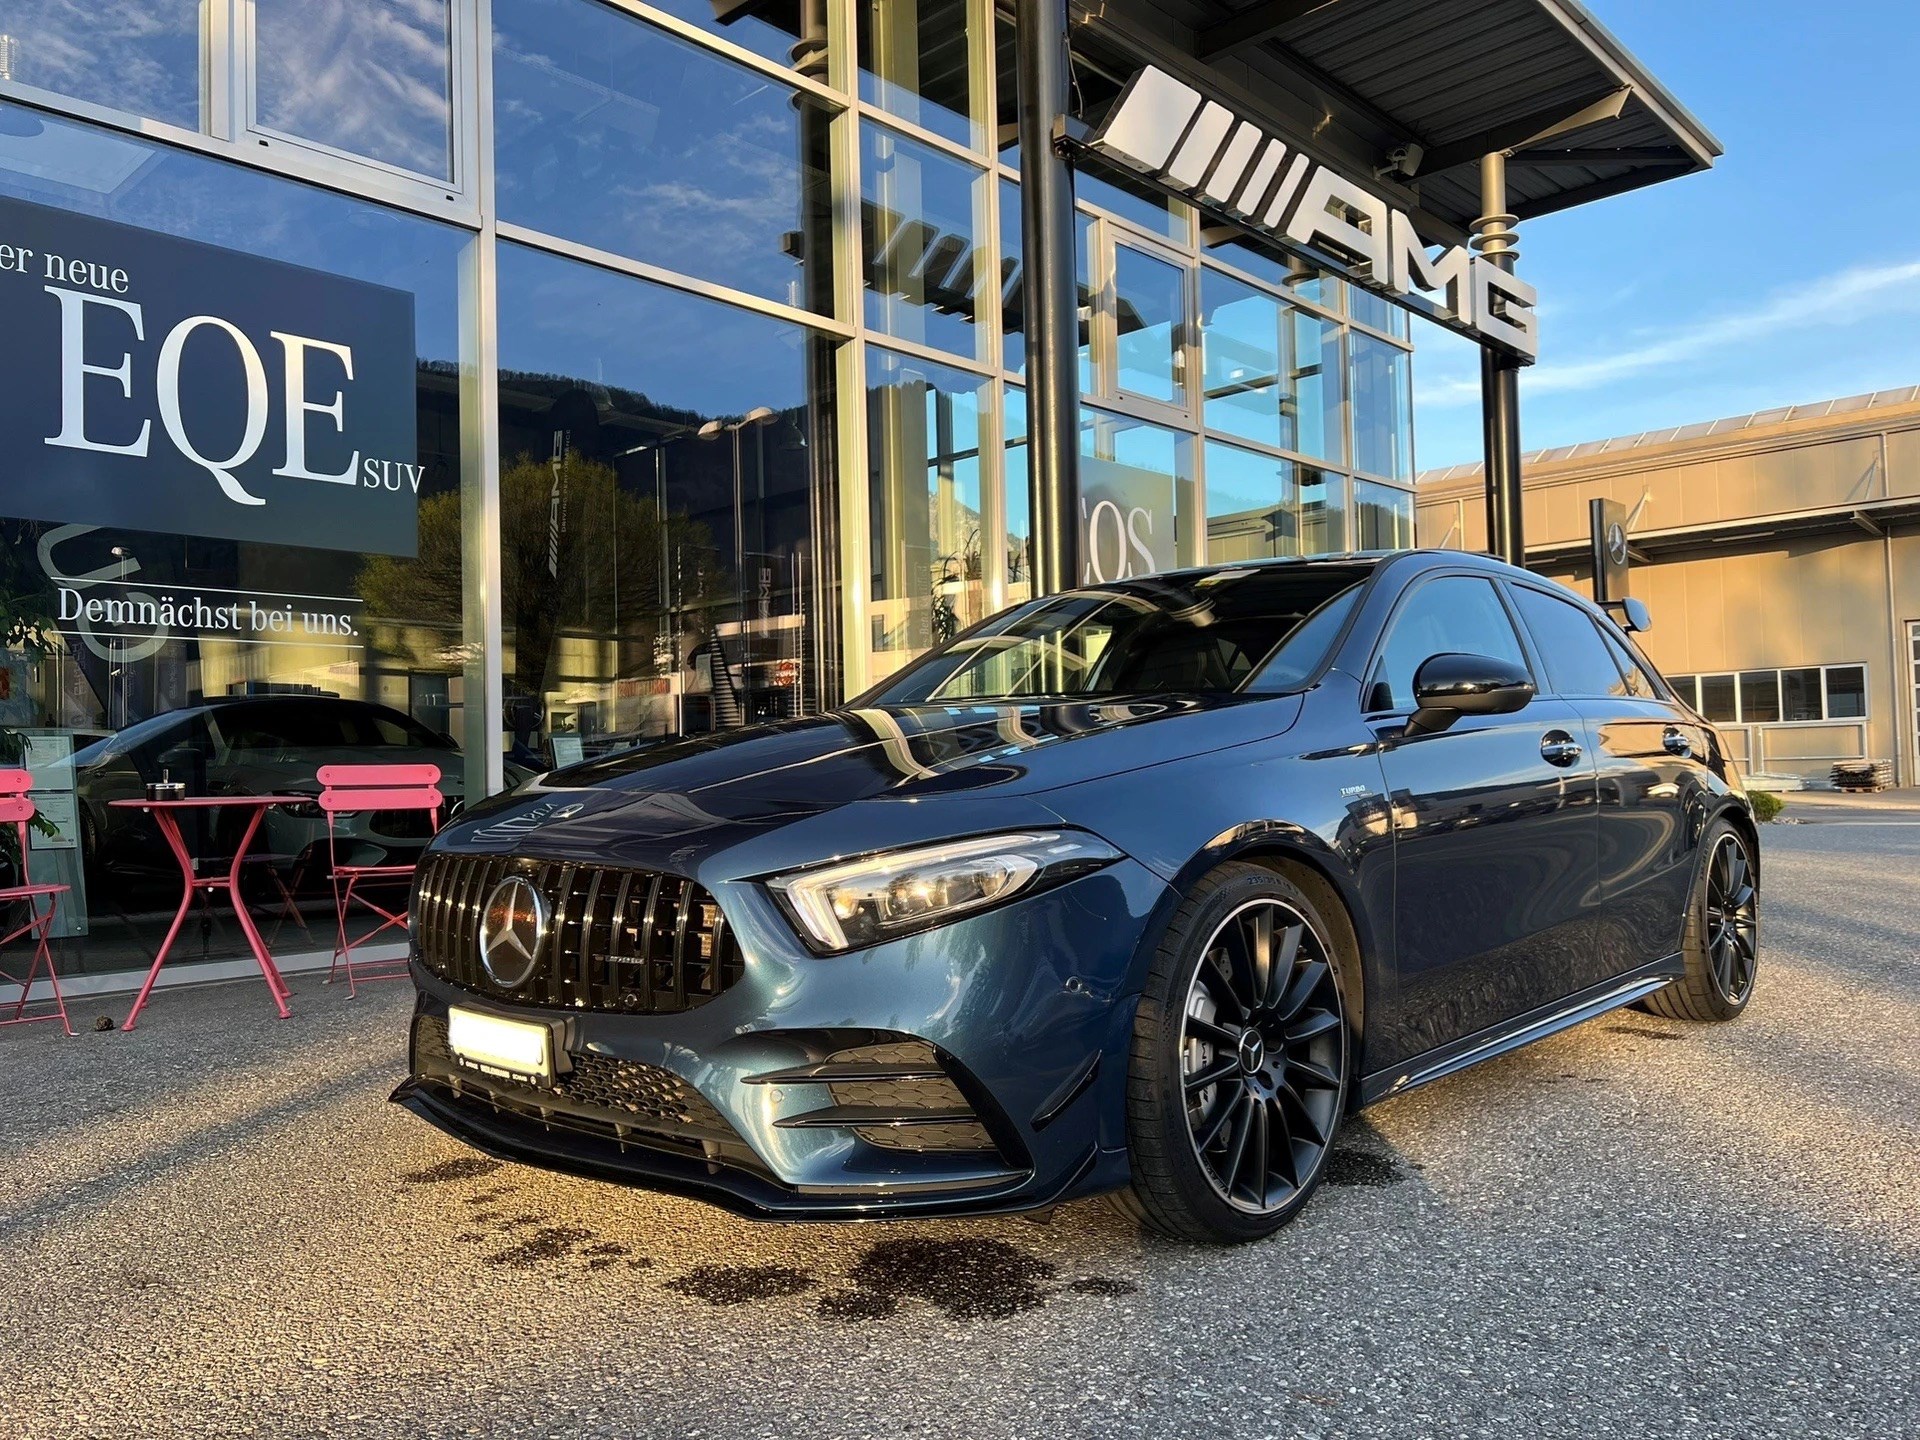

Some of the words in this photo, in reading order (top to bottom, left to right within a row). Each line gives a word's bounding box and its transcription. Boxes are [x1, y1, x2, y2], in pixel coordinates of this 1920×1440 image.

[44, 253, 129, 293] neue
[1286, 165, 1537, 360] AMG
[44, 284, 360, 506] EQE
[363, 457, 426, 495] SUV
[58, 587, 242, 631] Demnächst
[249, 598, 294, 632] bei
[303, 610, 359, 637] uns.
[1340, 784, 1366, 796] TURBO
